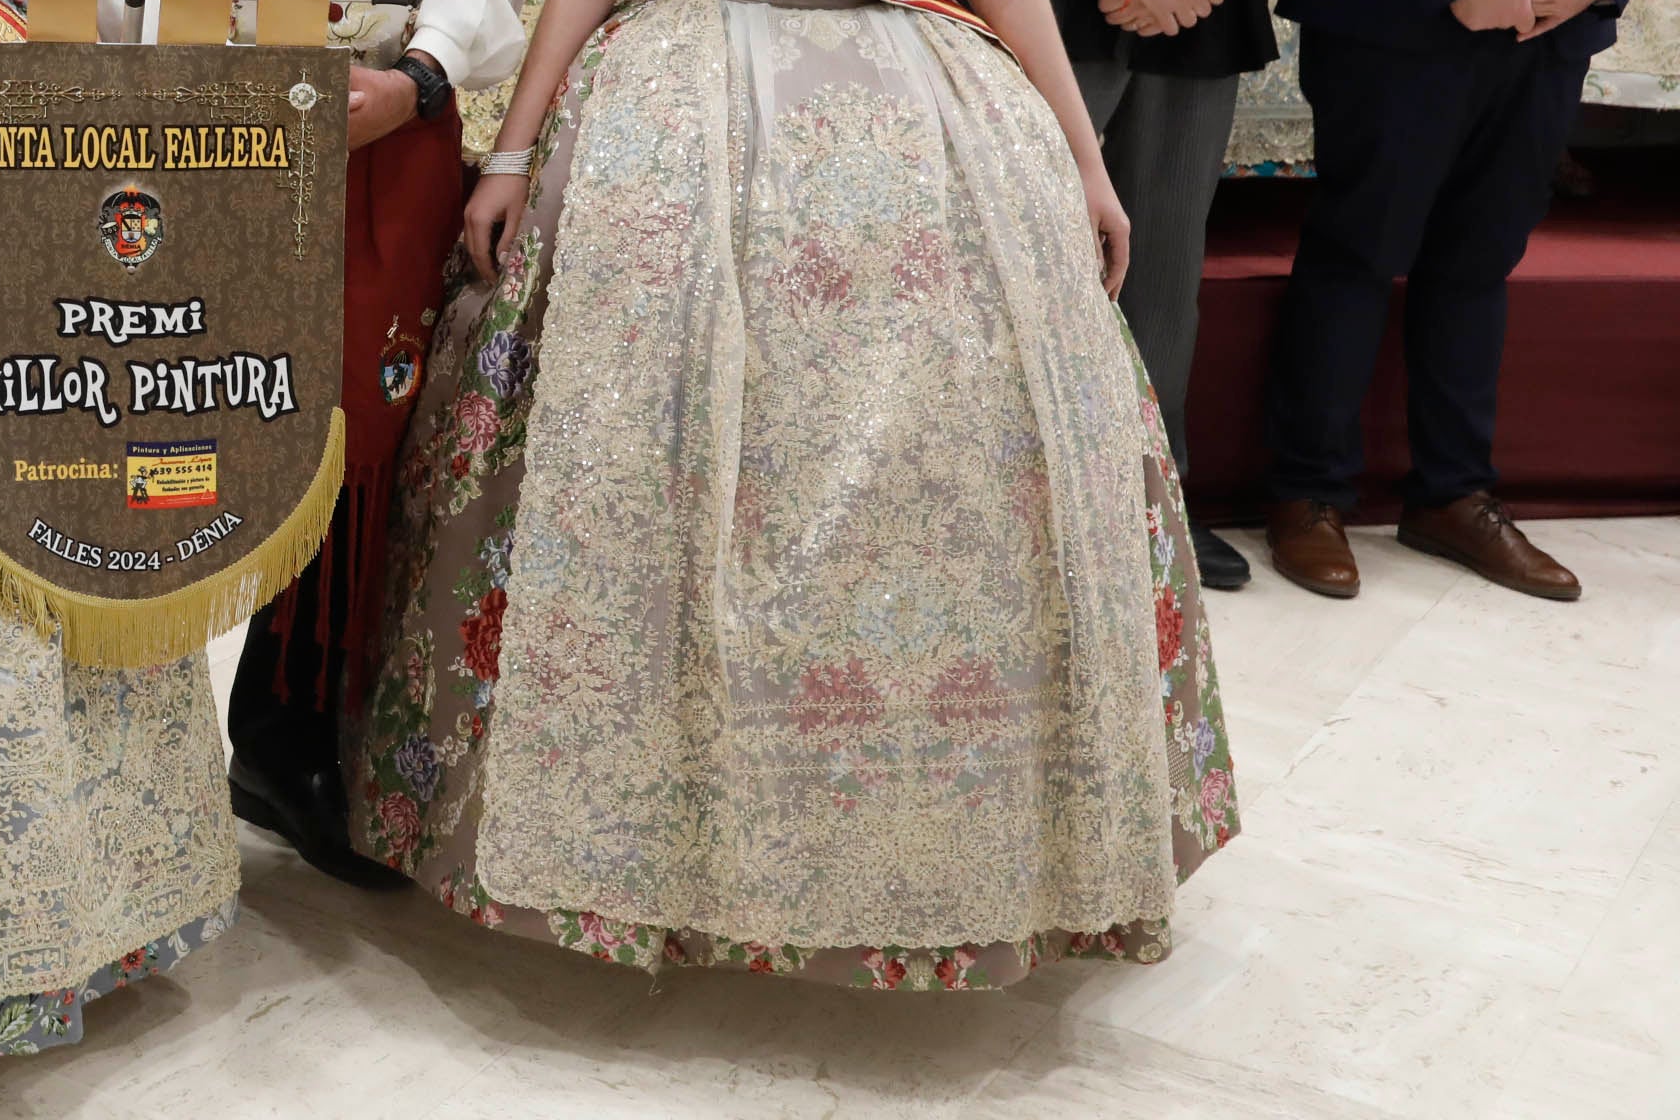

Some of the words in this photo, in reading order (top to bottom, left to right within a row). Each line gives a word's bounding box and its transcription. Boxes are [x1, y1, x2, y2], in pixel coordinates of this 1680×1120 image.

[63, 126, 157, 169] LOCAL
[164, 126, 289, 169] FALLERA
[14, 457, 119, 482] Patrocina:
[175, 465, 193, 475] 555
[195, 463, 212, 472] 414
[28, 518, 103, 568] FALLES
[107, 551, 161, 570] 2024
[176, 511, 243, 561] DÉNIA
